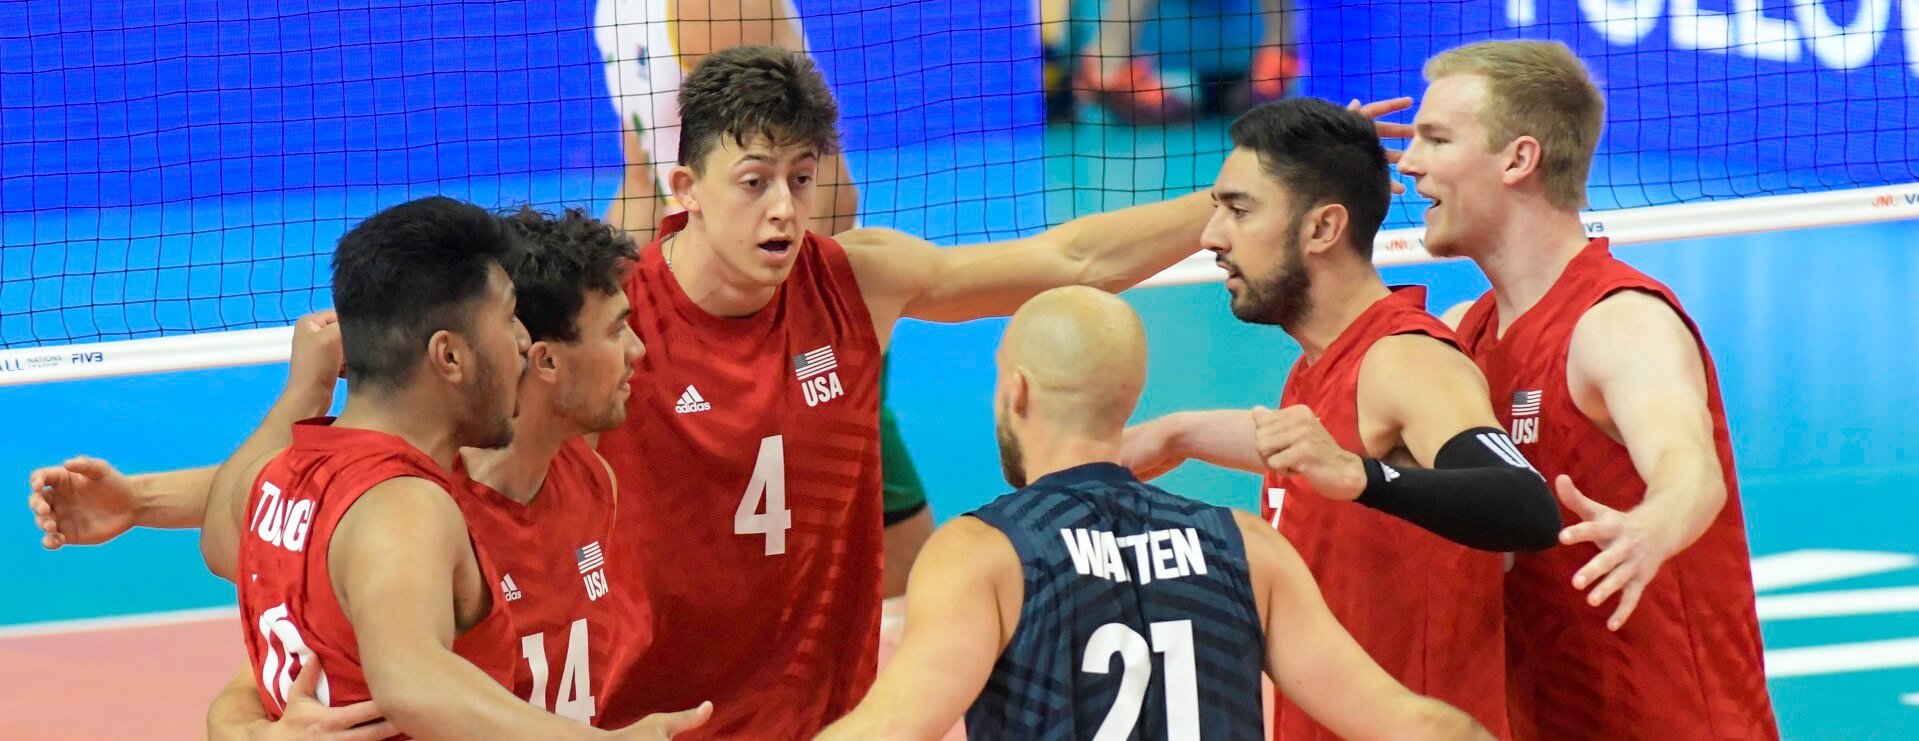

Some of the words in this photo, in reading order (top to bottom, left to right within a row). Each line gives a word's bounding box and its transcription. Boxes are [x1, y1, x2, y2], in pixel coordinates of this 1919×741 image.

[72, 352, 103, 364] FIVB
[675, 401, 711, 413] adidas
[801, 371, 844, 407] USA
[734, 434, 791, 556] 4
[583, 568, 609, 601] USA
[521, 618, 596, 726] 14
[1081, 619, 1201, 741] 21
